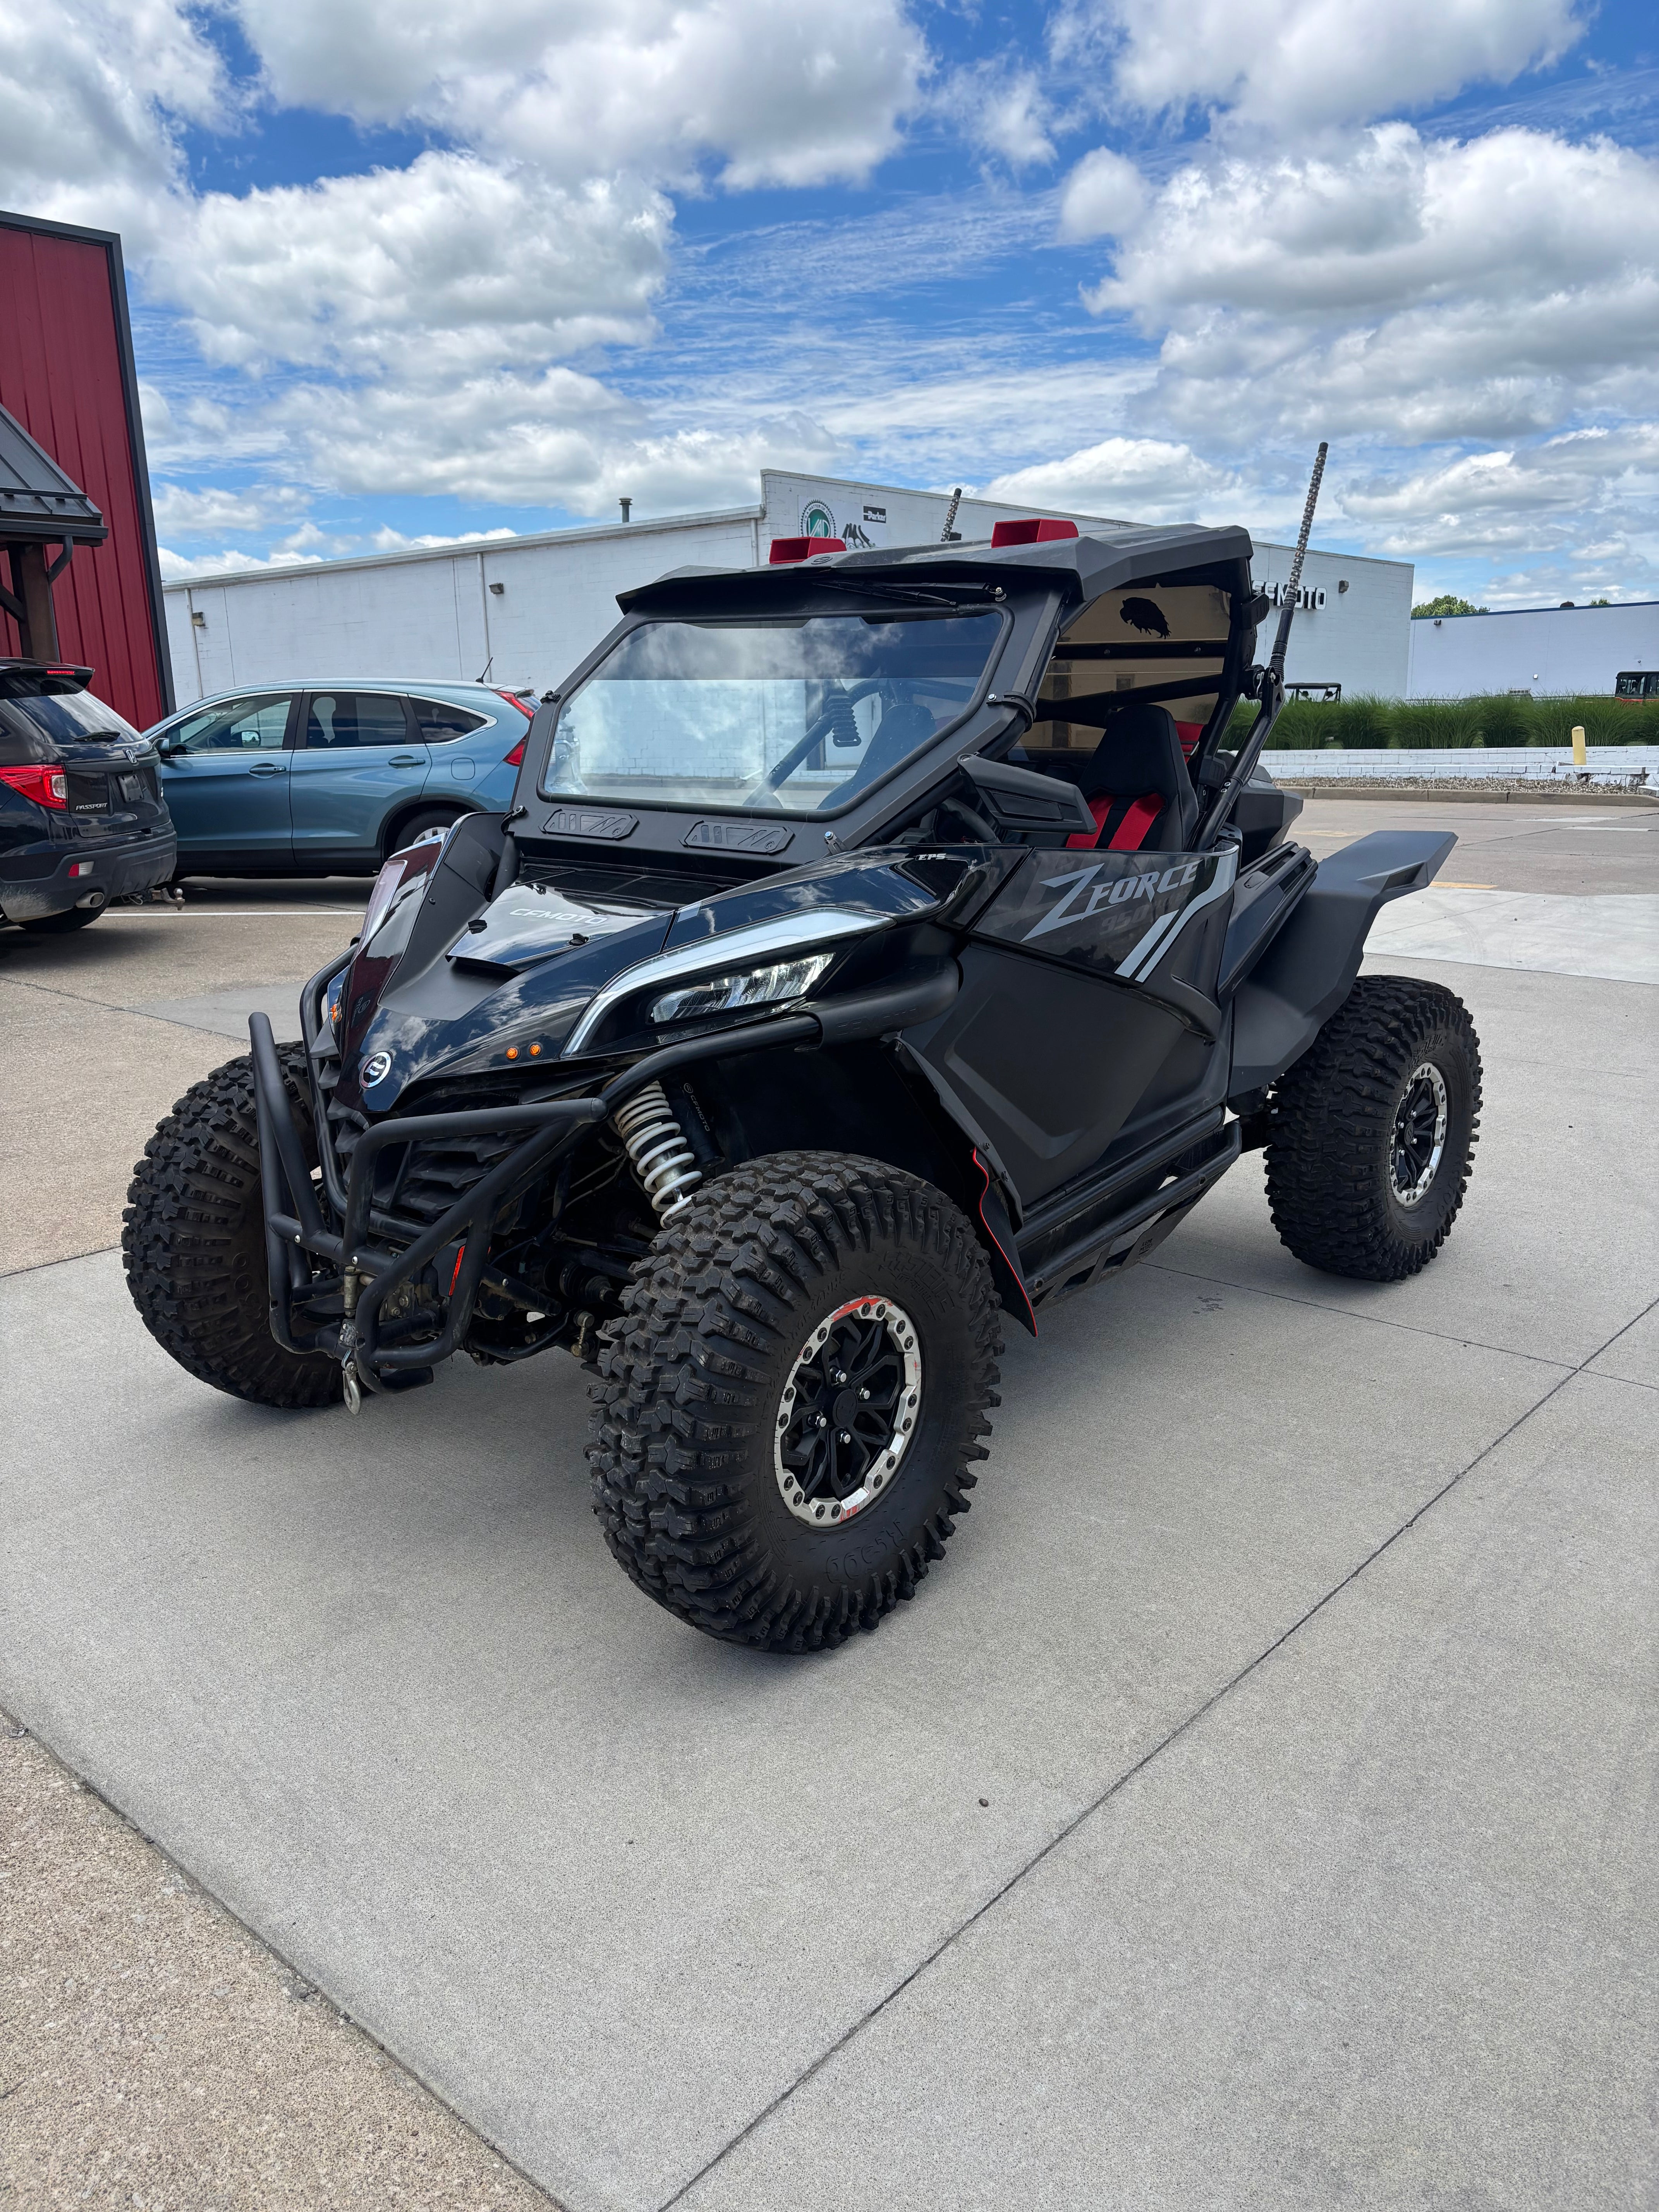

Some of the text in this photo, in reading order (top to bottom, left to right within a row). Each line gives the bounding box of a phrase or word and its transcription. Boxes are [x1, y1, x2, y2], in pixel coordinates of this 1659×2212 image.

[868, 511, 886, 521] Parker
[509, 908, 607, 924] CFMOTO
[691, 1095, 710, 1131] CFMOTO
